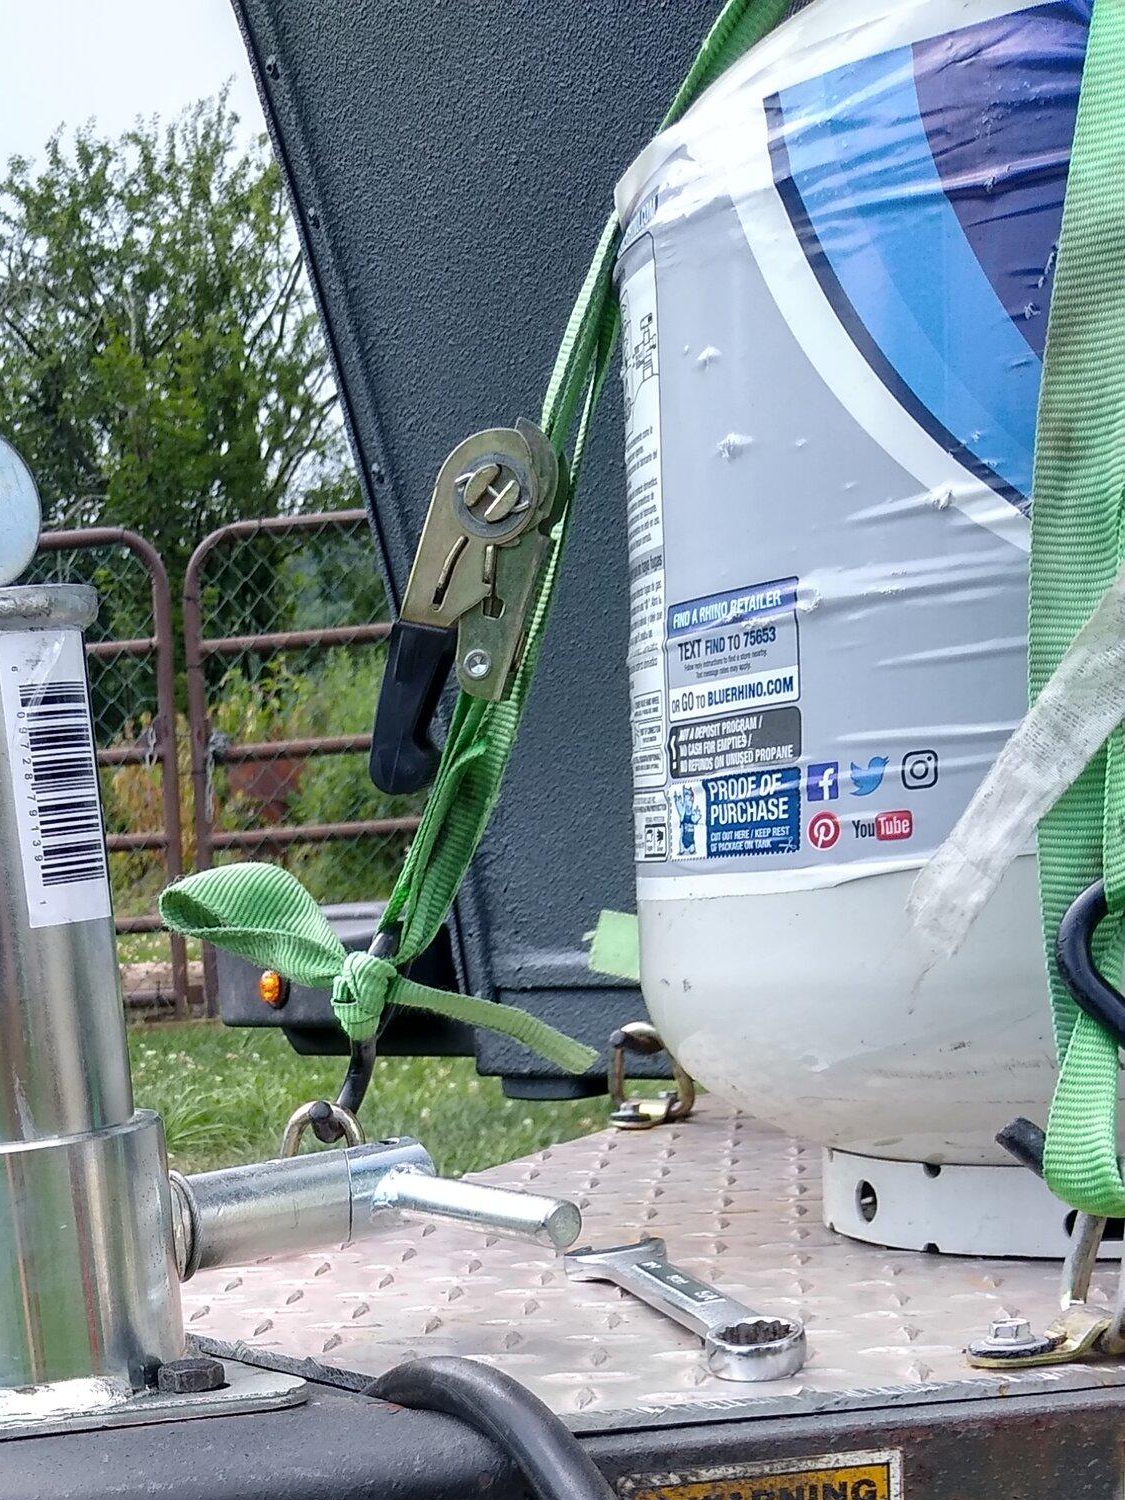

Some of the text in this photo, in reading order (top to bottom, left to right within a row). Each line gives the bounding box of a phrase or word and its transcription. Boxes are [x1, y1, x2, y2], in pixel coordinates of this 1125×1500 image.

[673, 610, 690, 629] FIND
[692, 608, 698, 624] A
[699, 601, 728, 622] RHINO
[730, 589, 782, 614] RETAILER
[677, 638, 702, 661] TEXT
[705, 636, 725, 656] FIND
[727, 634, 741, 650] TO
[743, 626, 776, 648] 75653
[672, 699, 680, 714] OR
[681, 692, 694, 712] GO
[695, 694, 705, 709] TO
[707, 676, 794, 707] BLUERHINO.COM
[695, 723, 721, 740] DEPOSIT
[721, 716, 757, 736] PROGRAM
[688, 742, 703, 757] CASH
[704, 740, 716, 754] FOR
[716, 734, 747, 752] EMPTIES
[688, 757, 714, 771] REFUNDS
[715, 755, 725, 769] ON
[726, 750, 754, 767] UNUSED
[755, 744, 794, 762] PROPANE
[708, 773, 782, 801] PROOF OF
[710, 797, 789, 826] PURCHASE
[26, 794, 44, 862] 79139
[734, 829, 749, 840] HERE
[755, 827, 771, 837] KEEP
[772, 826, 790, 836] REST
[852, 817, 910, 839] YouTube
[710, 839, 772, 852] OF PACKAGE ON TANK
